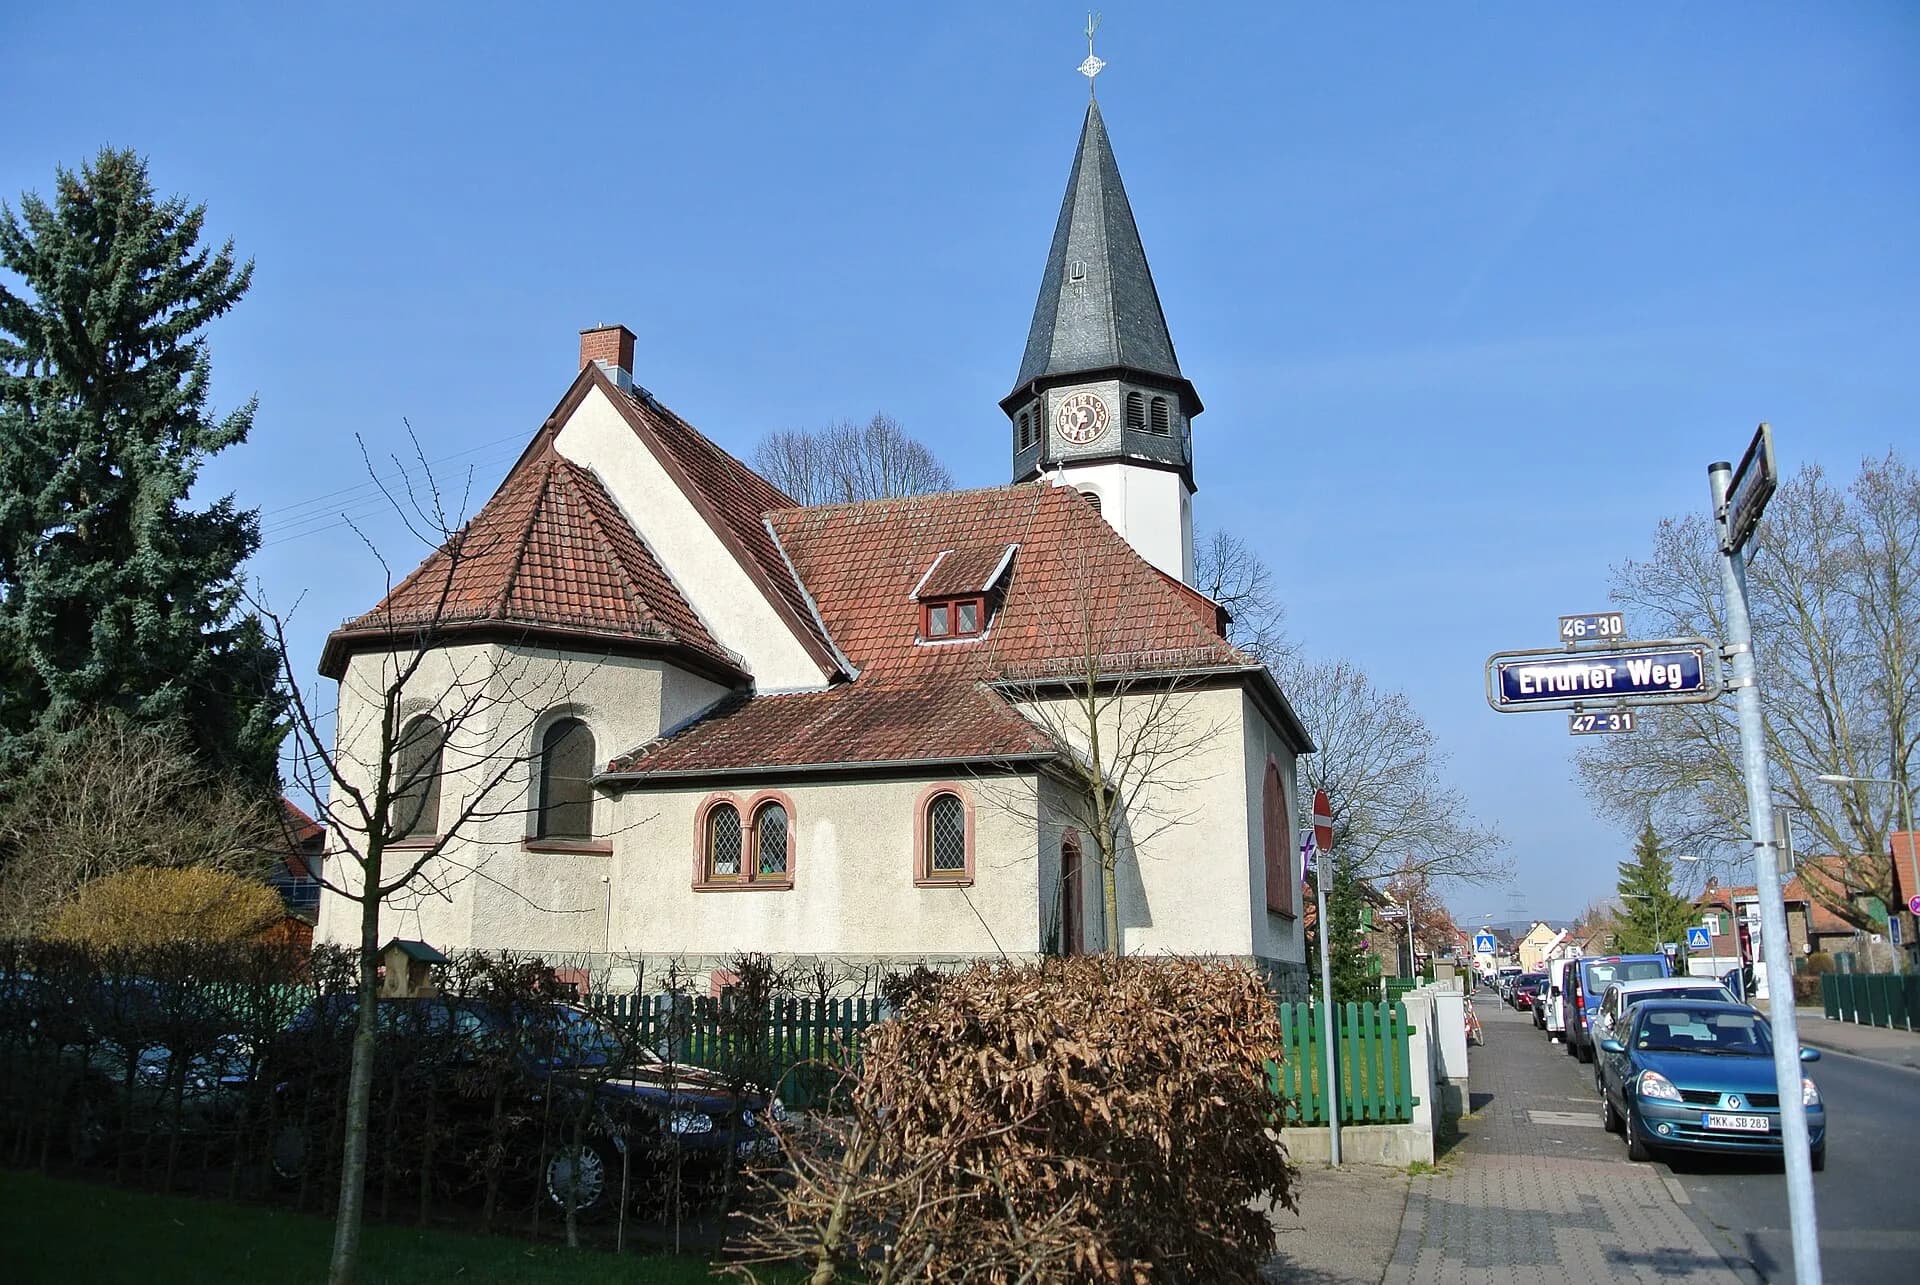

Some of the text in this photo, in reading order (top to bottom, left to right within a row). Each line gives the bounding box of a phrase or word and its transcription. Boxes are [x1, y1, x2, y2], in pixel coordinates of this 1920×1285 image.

[1562, 616, 1622, 637] 46-30
[1626, 659, 1682, 689] Weg
[1572, 713, 1632, 732] 47-31
[1709, 1115, 1768, 1129] MKK SB 283
